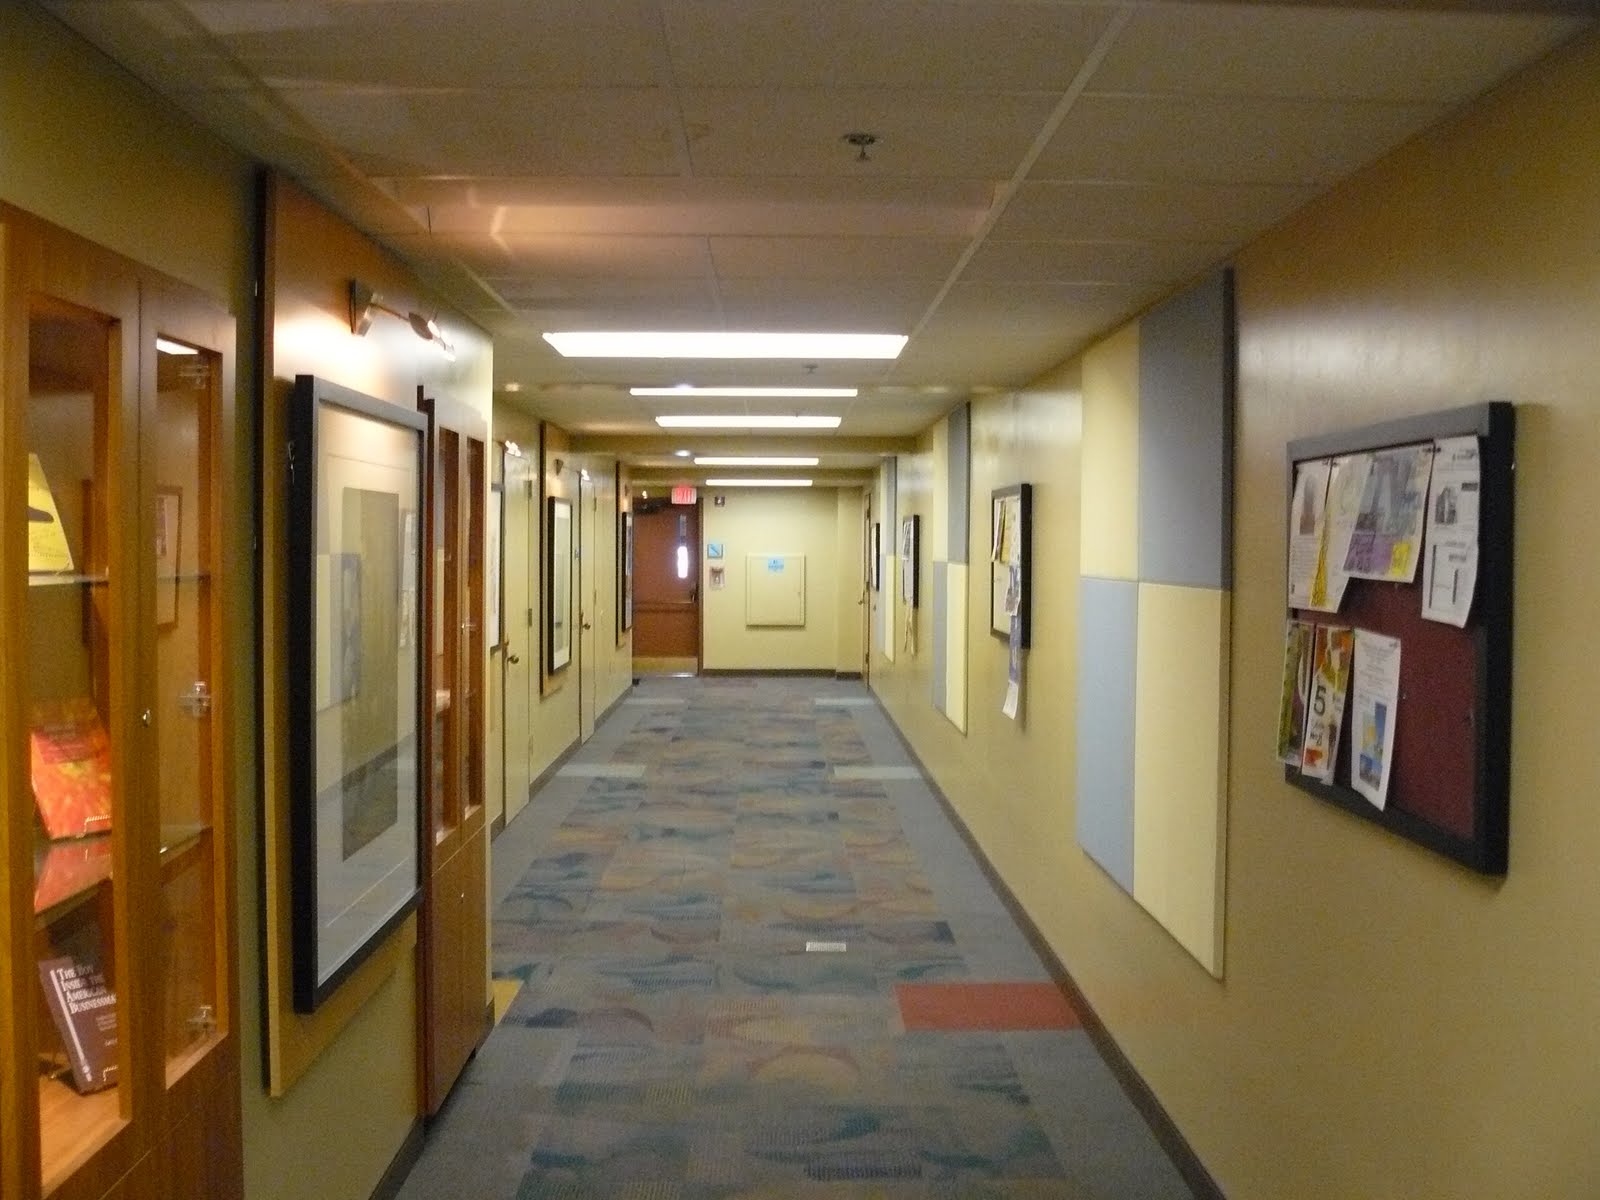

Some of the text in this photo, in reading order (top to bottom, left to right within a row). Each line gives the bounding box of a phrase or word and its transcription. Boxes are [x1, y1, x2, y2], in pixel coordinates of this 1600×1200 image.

[1313, 685, 1327, 716] 5
[56, 967, 76, 981] THE
[69, 993, 117, 1014] BUSINESSMA
